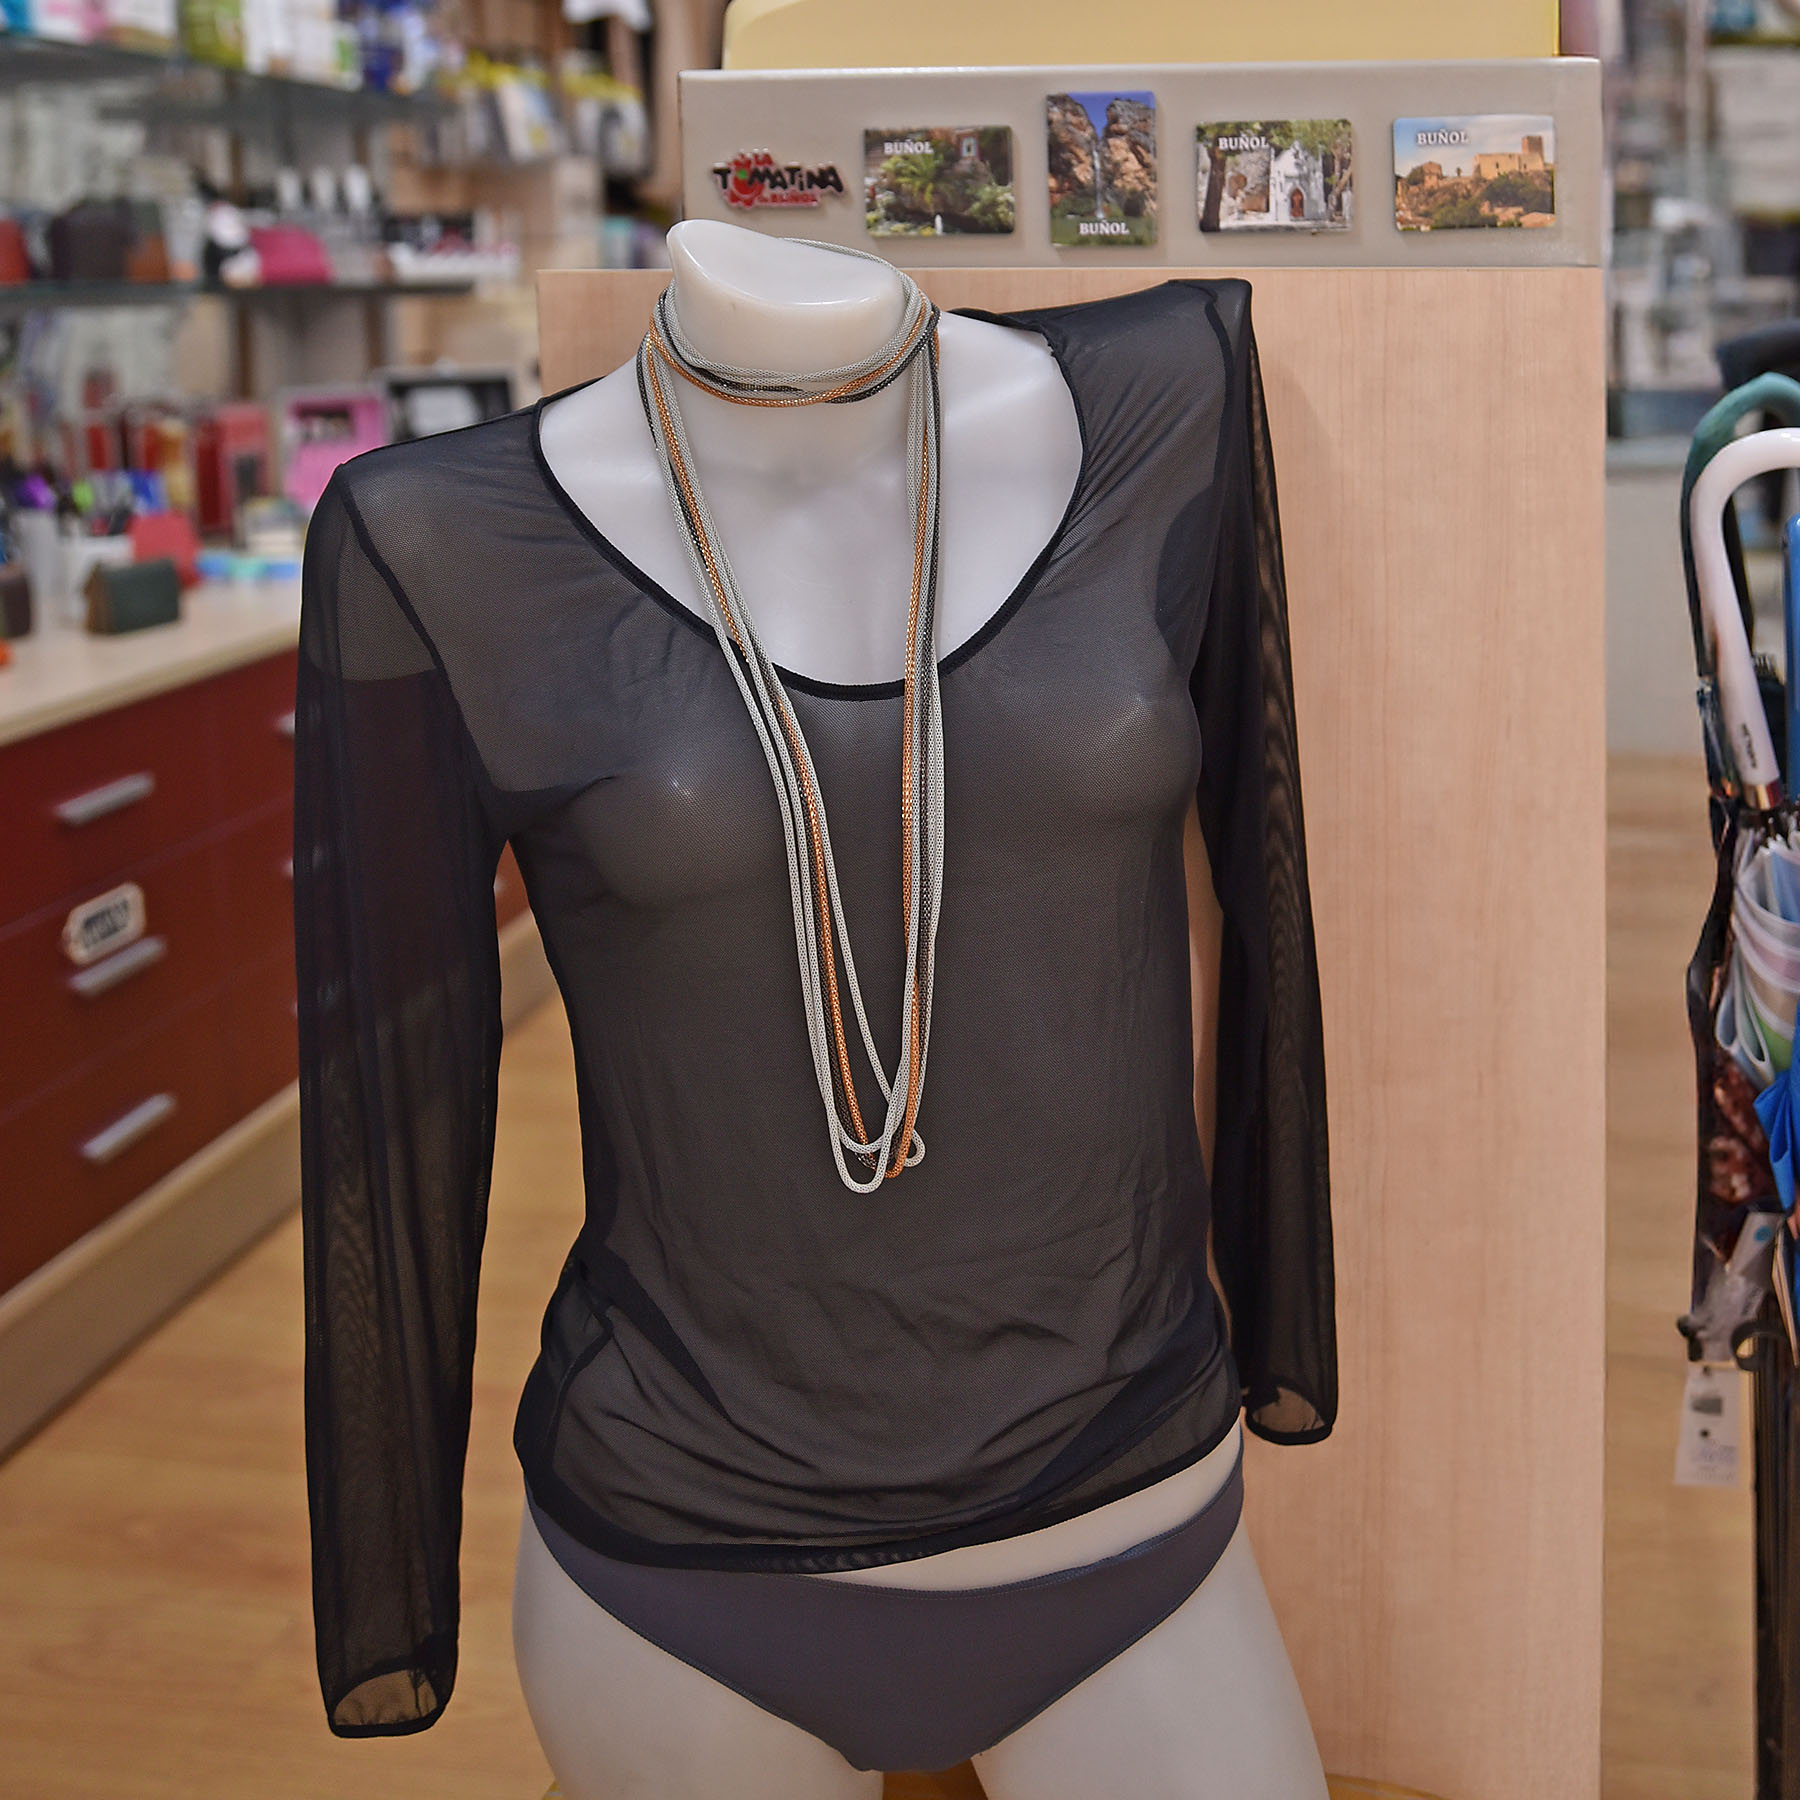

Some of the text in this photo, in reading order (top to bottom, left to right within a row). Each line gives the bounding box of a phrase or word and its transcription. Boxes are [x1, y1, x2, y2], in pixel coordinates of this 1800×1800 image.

[1218, 133, 1270, 151] BUÑOL
[1417, 128, 1470, 145] BUÑOL
[883, 138, 935, 155] BUÑOL
[1079, 219, 1130, 235] BUÑOL
